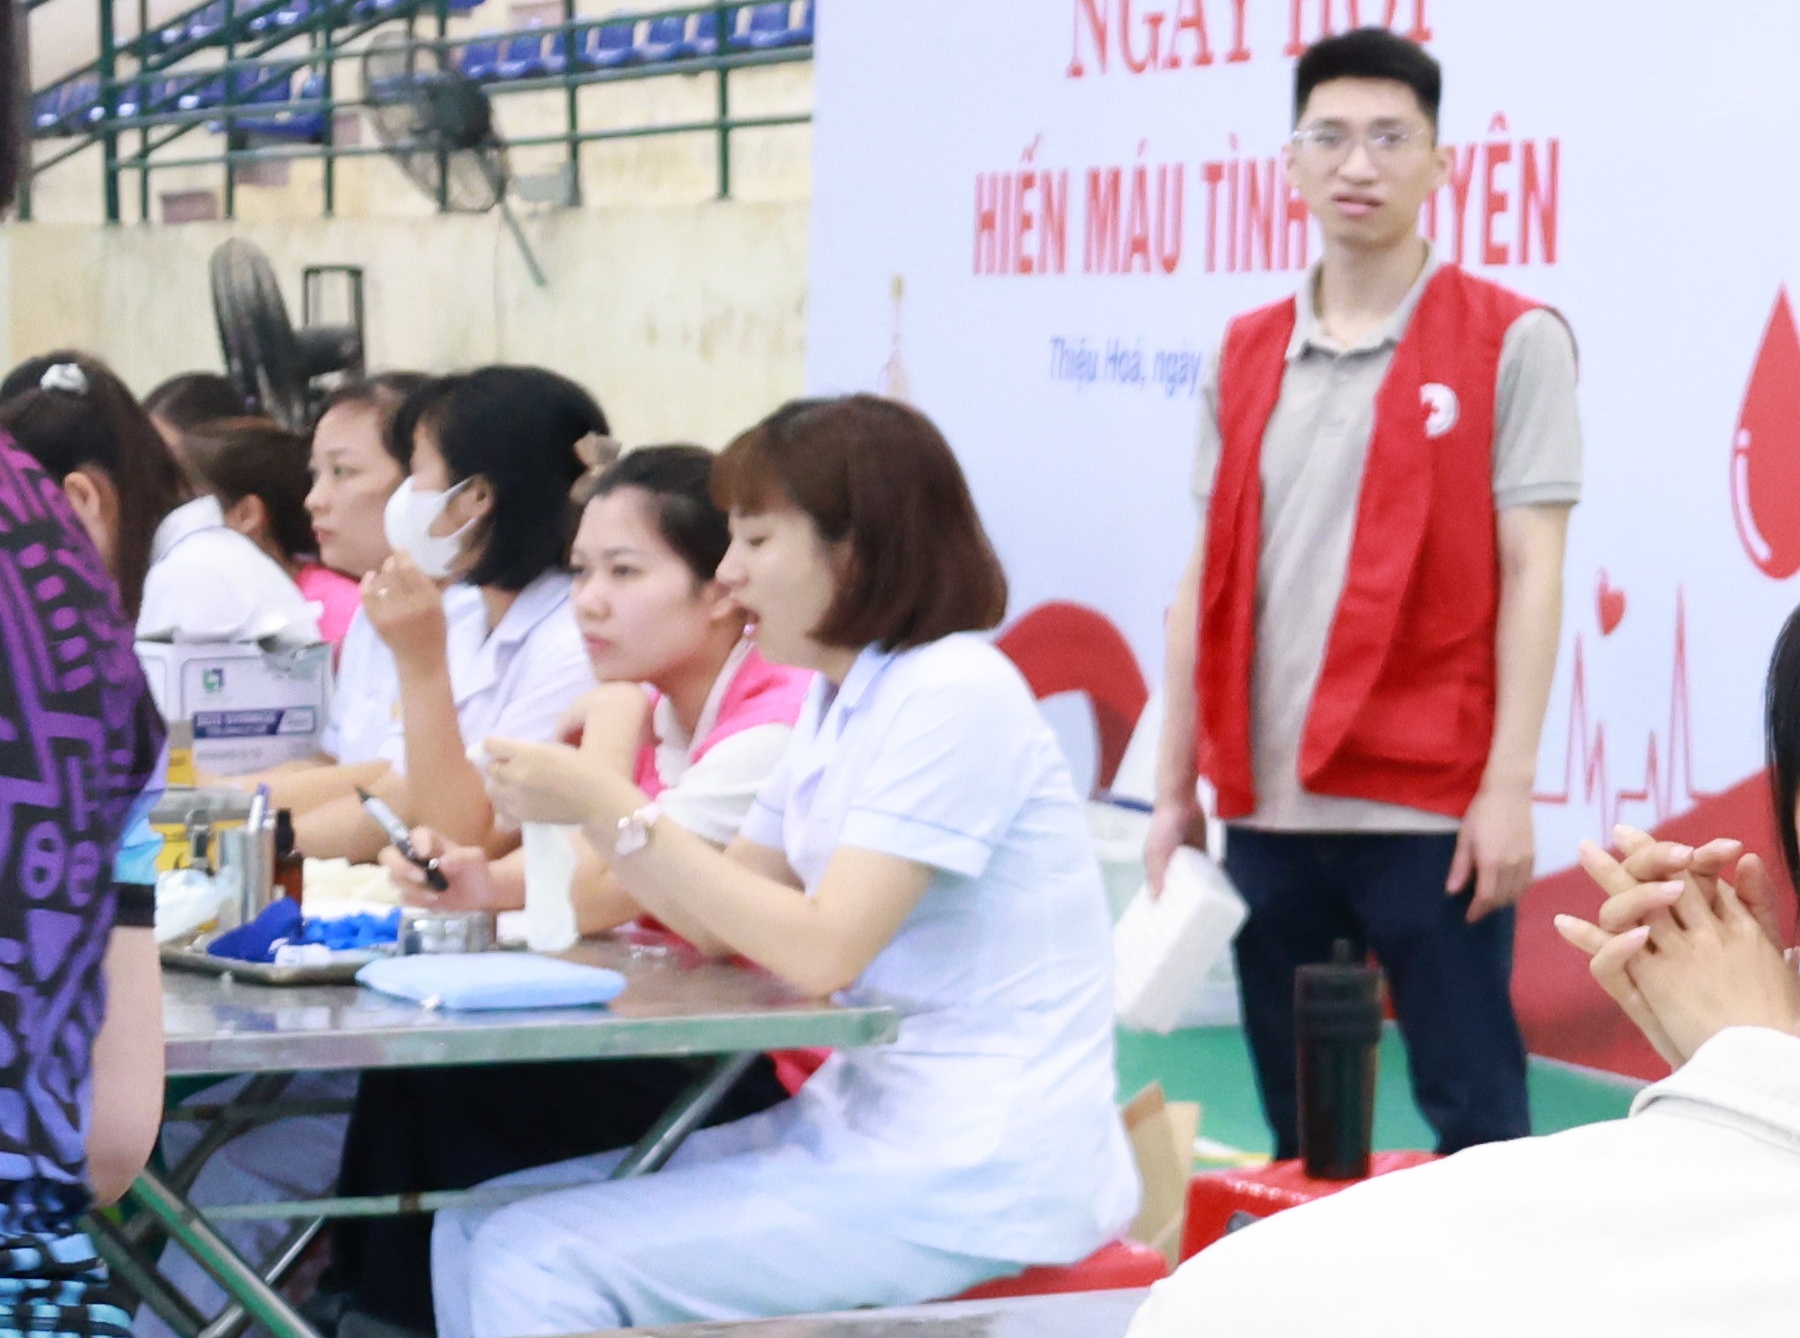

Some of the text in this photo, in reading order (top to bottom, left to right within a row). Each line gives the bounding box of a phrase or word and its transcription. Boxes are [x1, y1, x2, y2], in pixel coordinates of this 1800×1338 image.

[973, 132, 1068, 275] HIẾN
[1083, 137, 1184, 275] MÁU
[1201, 131, 1310, 273] TÌNH
[1050, 335, 1098, 392] Thiệu
[1151, 338, 1202, 398] ngày
